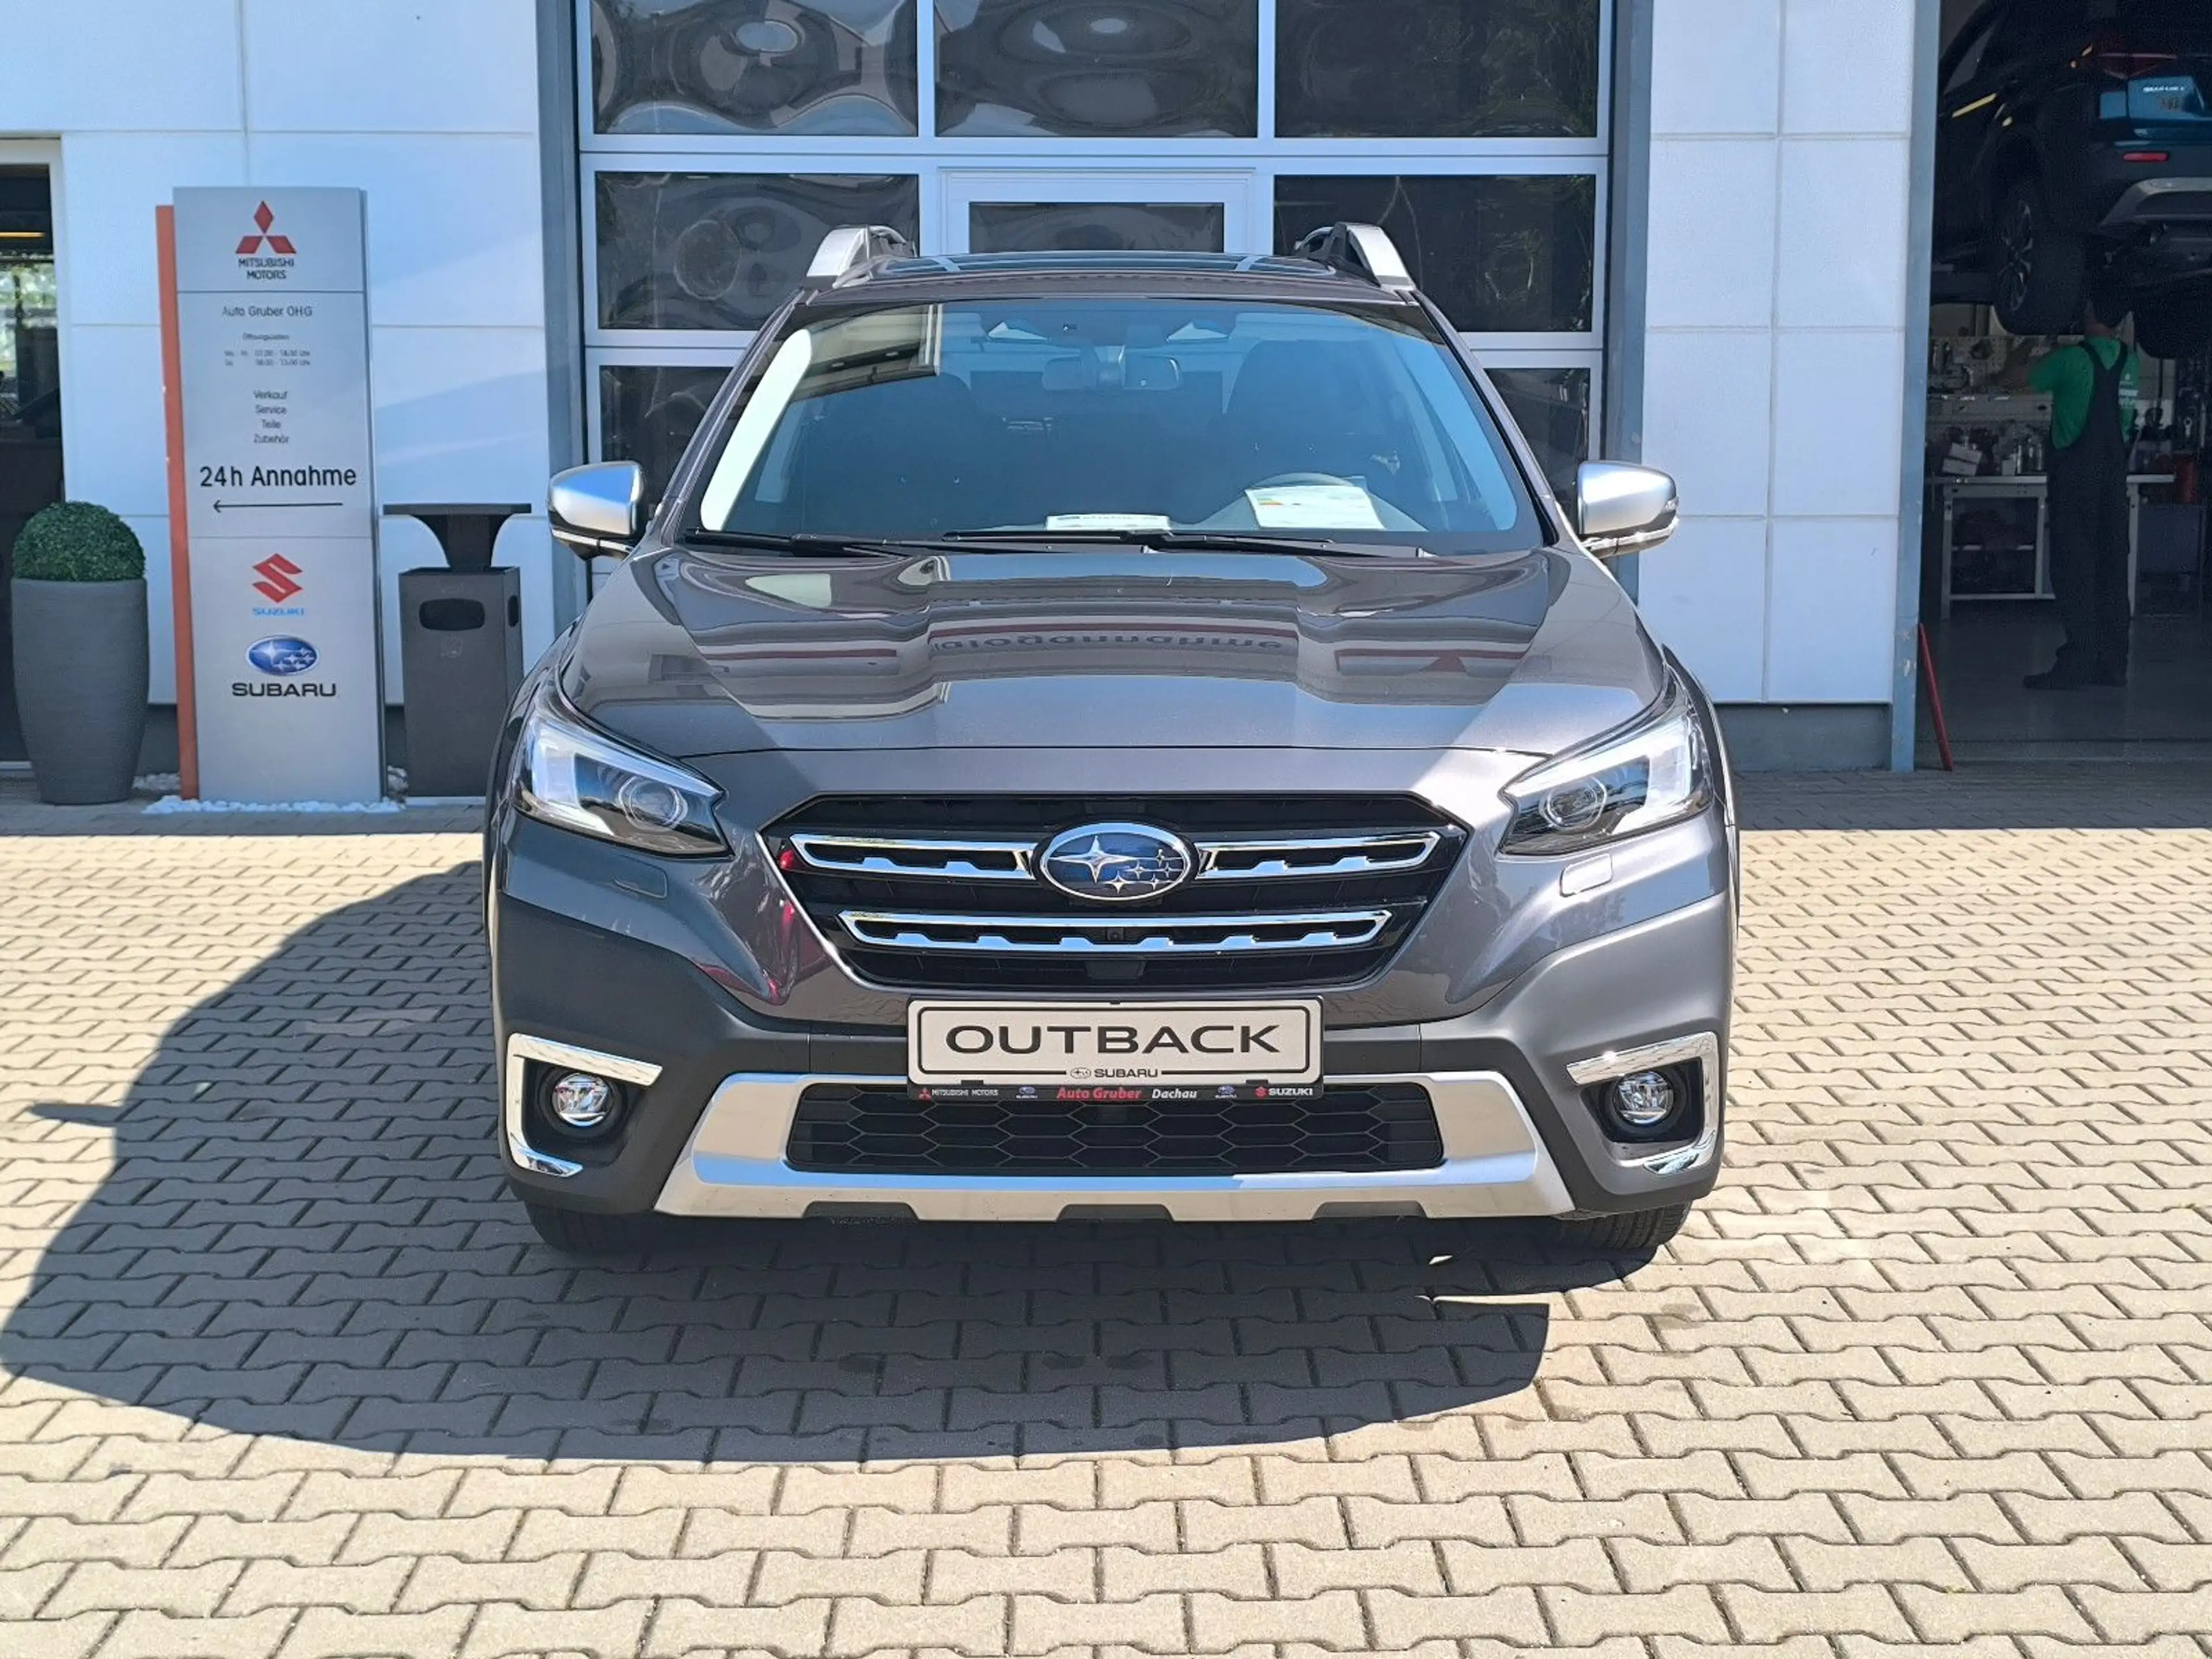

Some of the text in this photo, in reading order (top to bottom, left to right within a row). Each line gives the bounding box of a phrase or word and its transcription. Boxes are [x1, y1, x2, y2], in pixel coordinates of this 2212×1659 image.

[238, 258, 294, 268] MITSUBISHI
[247, 270, 286, 280] MOTORS
[222, 305, 313, 316] Auto Gruber OHG
[253, 391, 288, 400] Verkauf
[255, 405, 287, 414] Service
[262, 420, 281, 429] Teile
[254, 434, 290, 444] Zubehör
[199, 465, 357, 487] 24h Annahme
[252, 607, 305, 616] SUZUKI
[232, 683, 337, 697] SUBARU
[945, 1025, 1281, 1054] OUTBACK
[1094, 1068, 1158, 1079] SUBARU
[1056, 1086, 1198, 1099] Auto Gruber Dachau
[1268, 1088, 1314, 1096] SUZUKI
